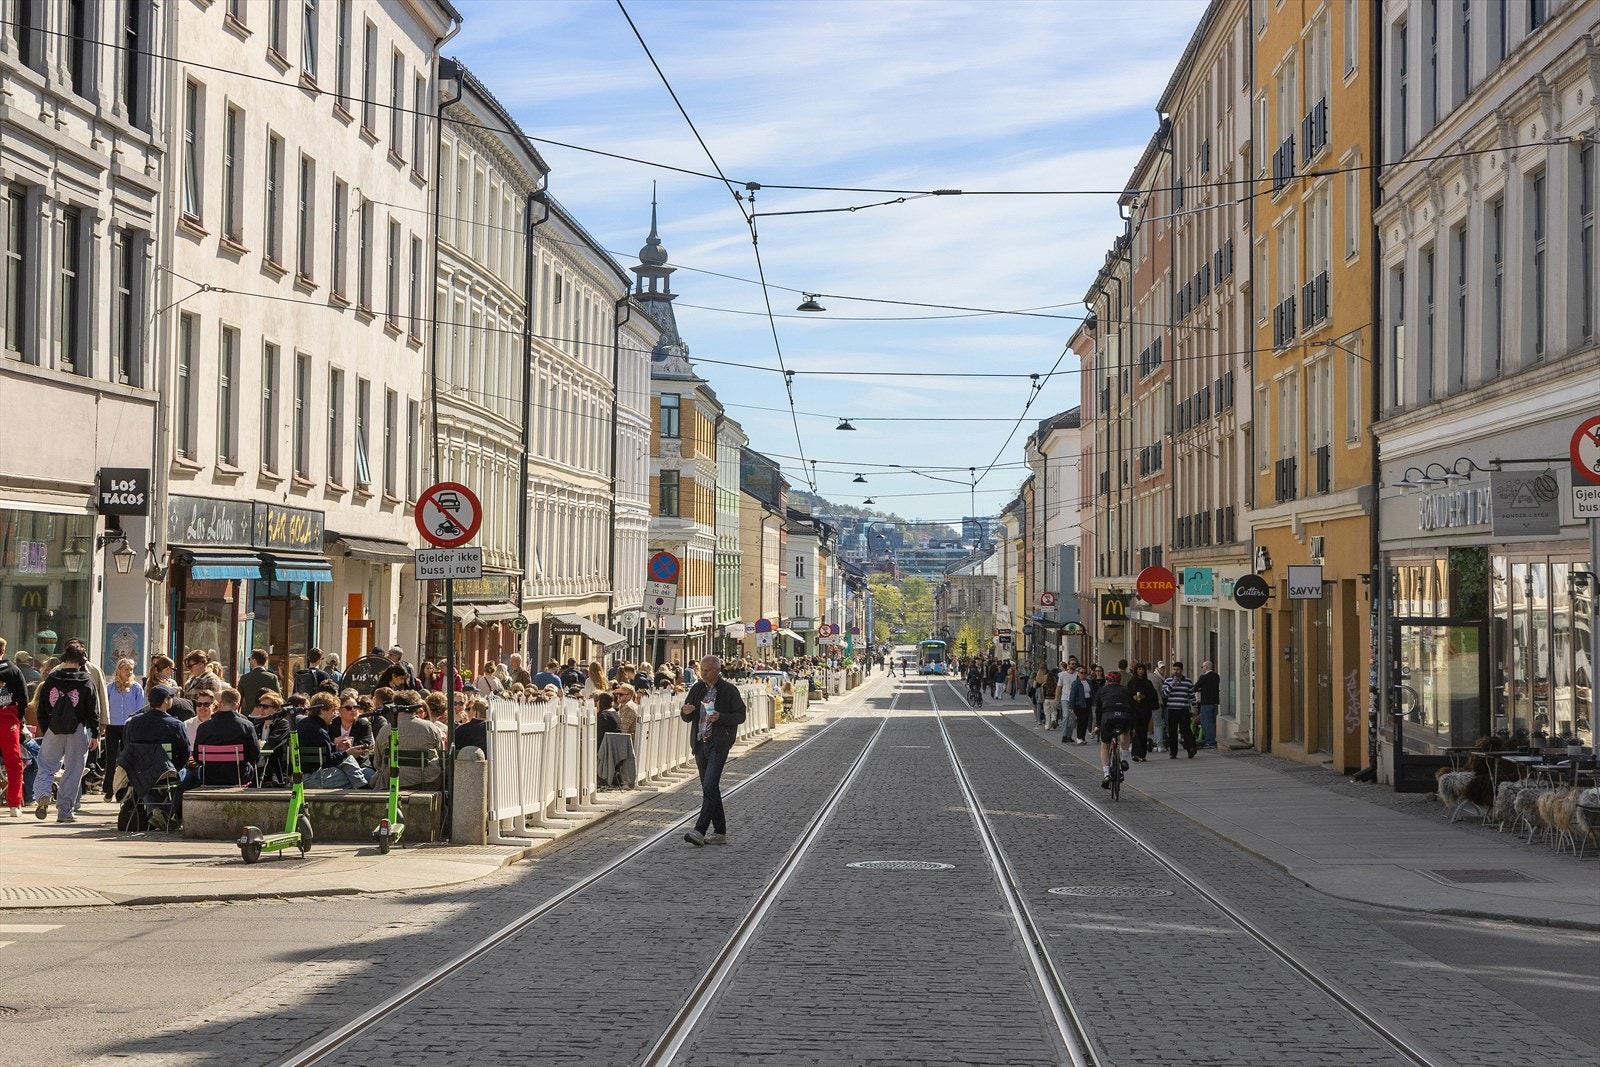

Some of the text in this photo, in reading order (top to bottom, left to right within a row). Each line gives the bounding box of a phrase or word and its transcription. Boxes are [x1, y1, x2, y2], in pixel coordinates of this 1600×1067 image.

[111, 479, 136, 492] LOS
[102, 492, 144, 505] TACOS
[1418, 491, 1463, 530] BØNDER
[1477, 486, 1491, 525] BY
[1579, 503, 1600, 512] bus
[187, 503, 233, 541] Los Lobos
[418, 552, 478, 564] Gjelder ikke
[421, 565, 476, 574] buss i rute
[1140, 582, 1175, 590] EXTRA
